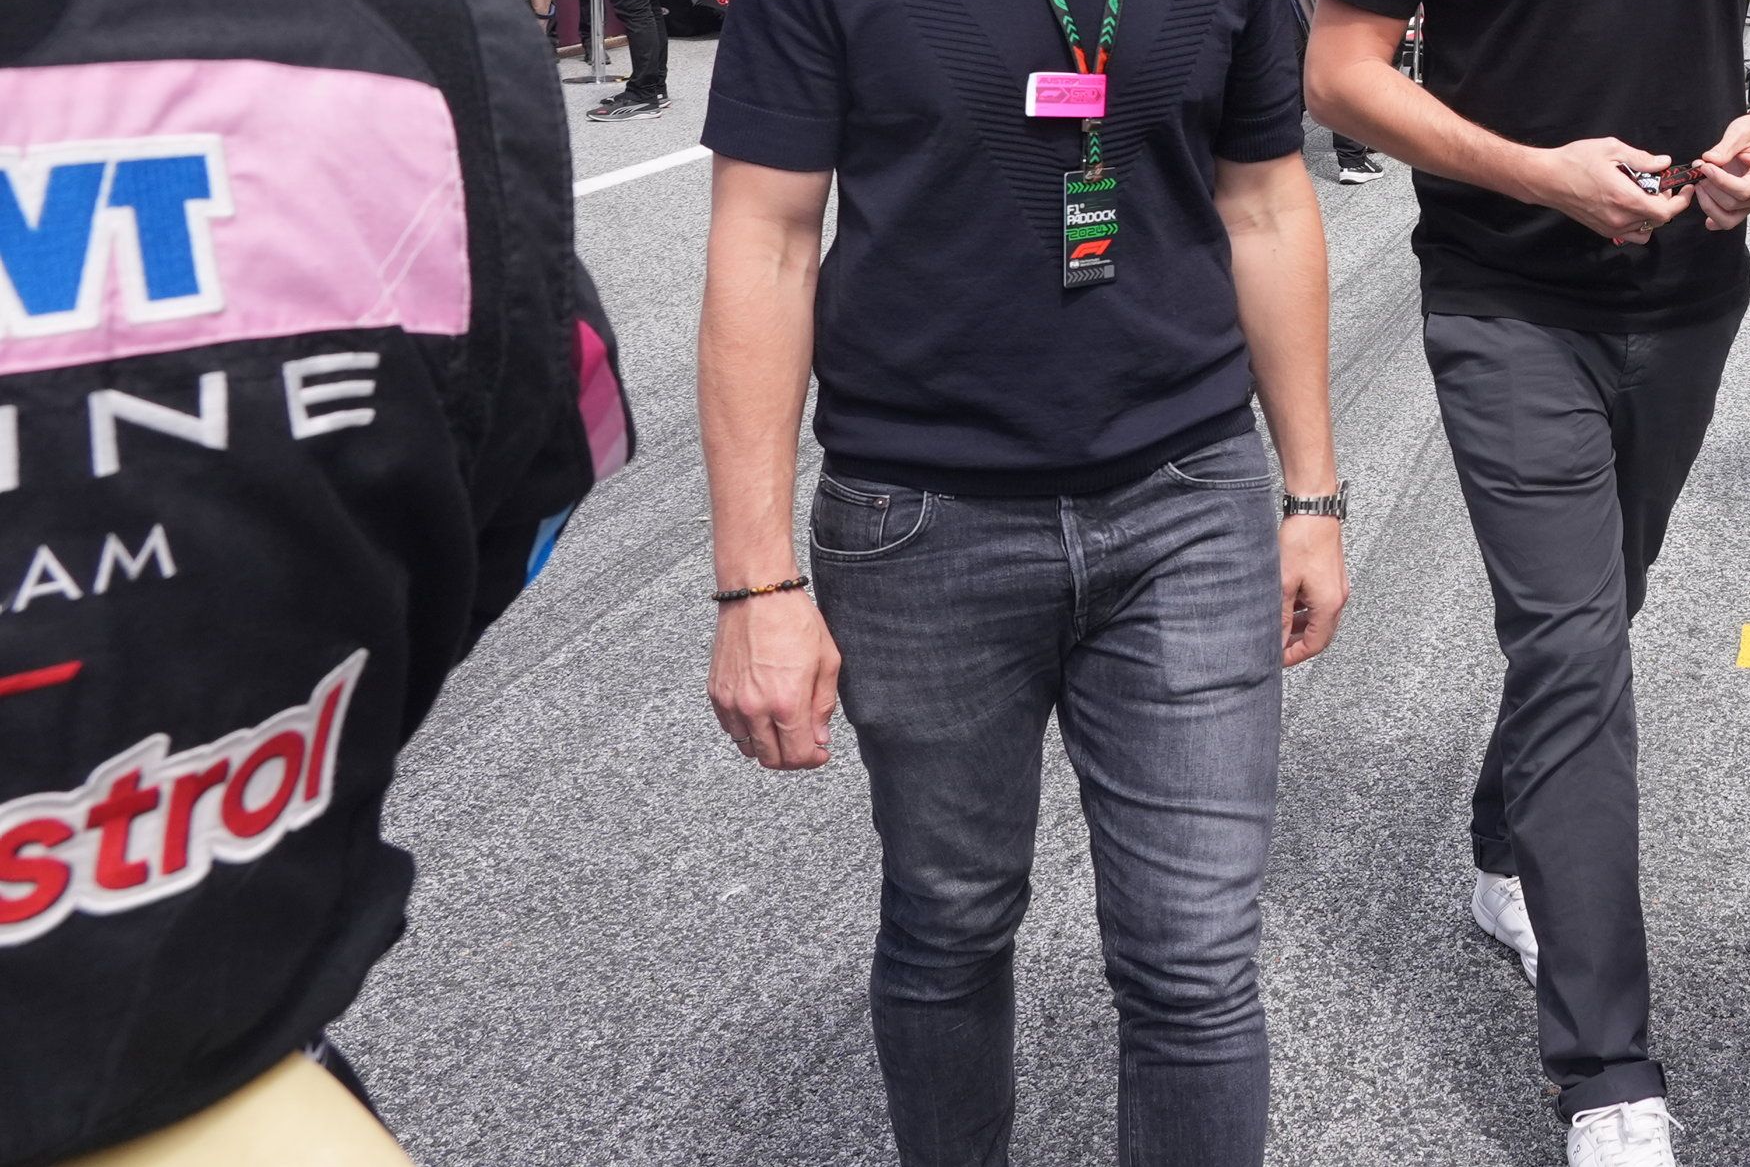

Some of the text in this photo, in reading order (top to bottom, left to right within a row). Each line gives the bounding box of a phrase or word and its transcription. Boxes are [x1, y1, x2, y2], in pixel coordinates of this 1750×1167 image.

[1067, 209, 1117, 226] PADDOCK
[1069, 225, 1108, 240] 2024
[0, 522, 177, 614] AM
